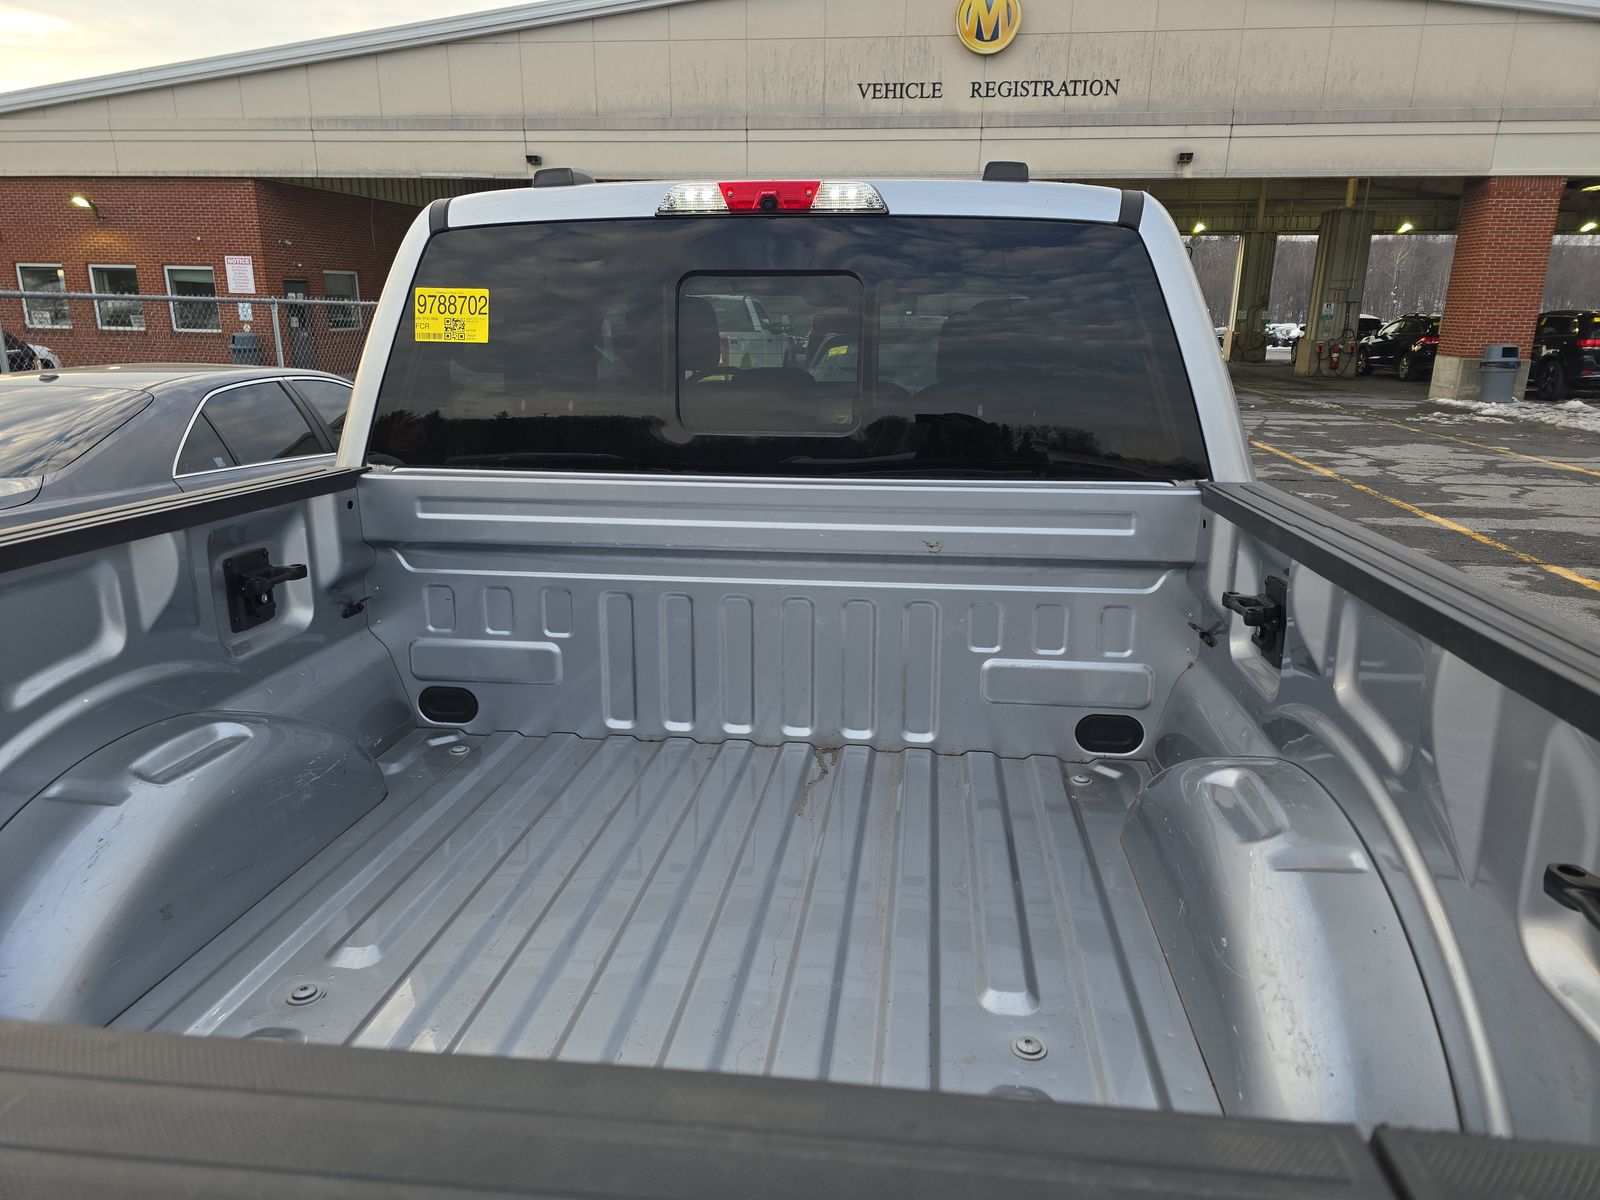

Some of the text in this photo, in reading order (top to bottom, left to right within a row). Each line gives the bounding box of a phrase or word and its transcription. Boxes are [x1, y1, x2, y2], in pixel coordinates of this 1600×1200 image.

[857, 79, 1120, 99] VEHICLE REGISTRATION
[417, 294, 488, 316] 9788702
